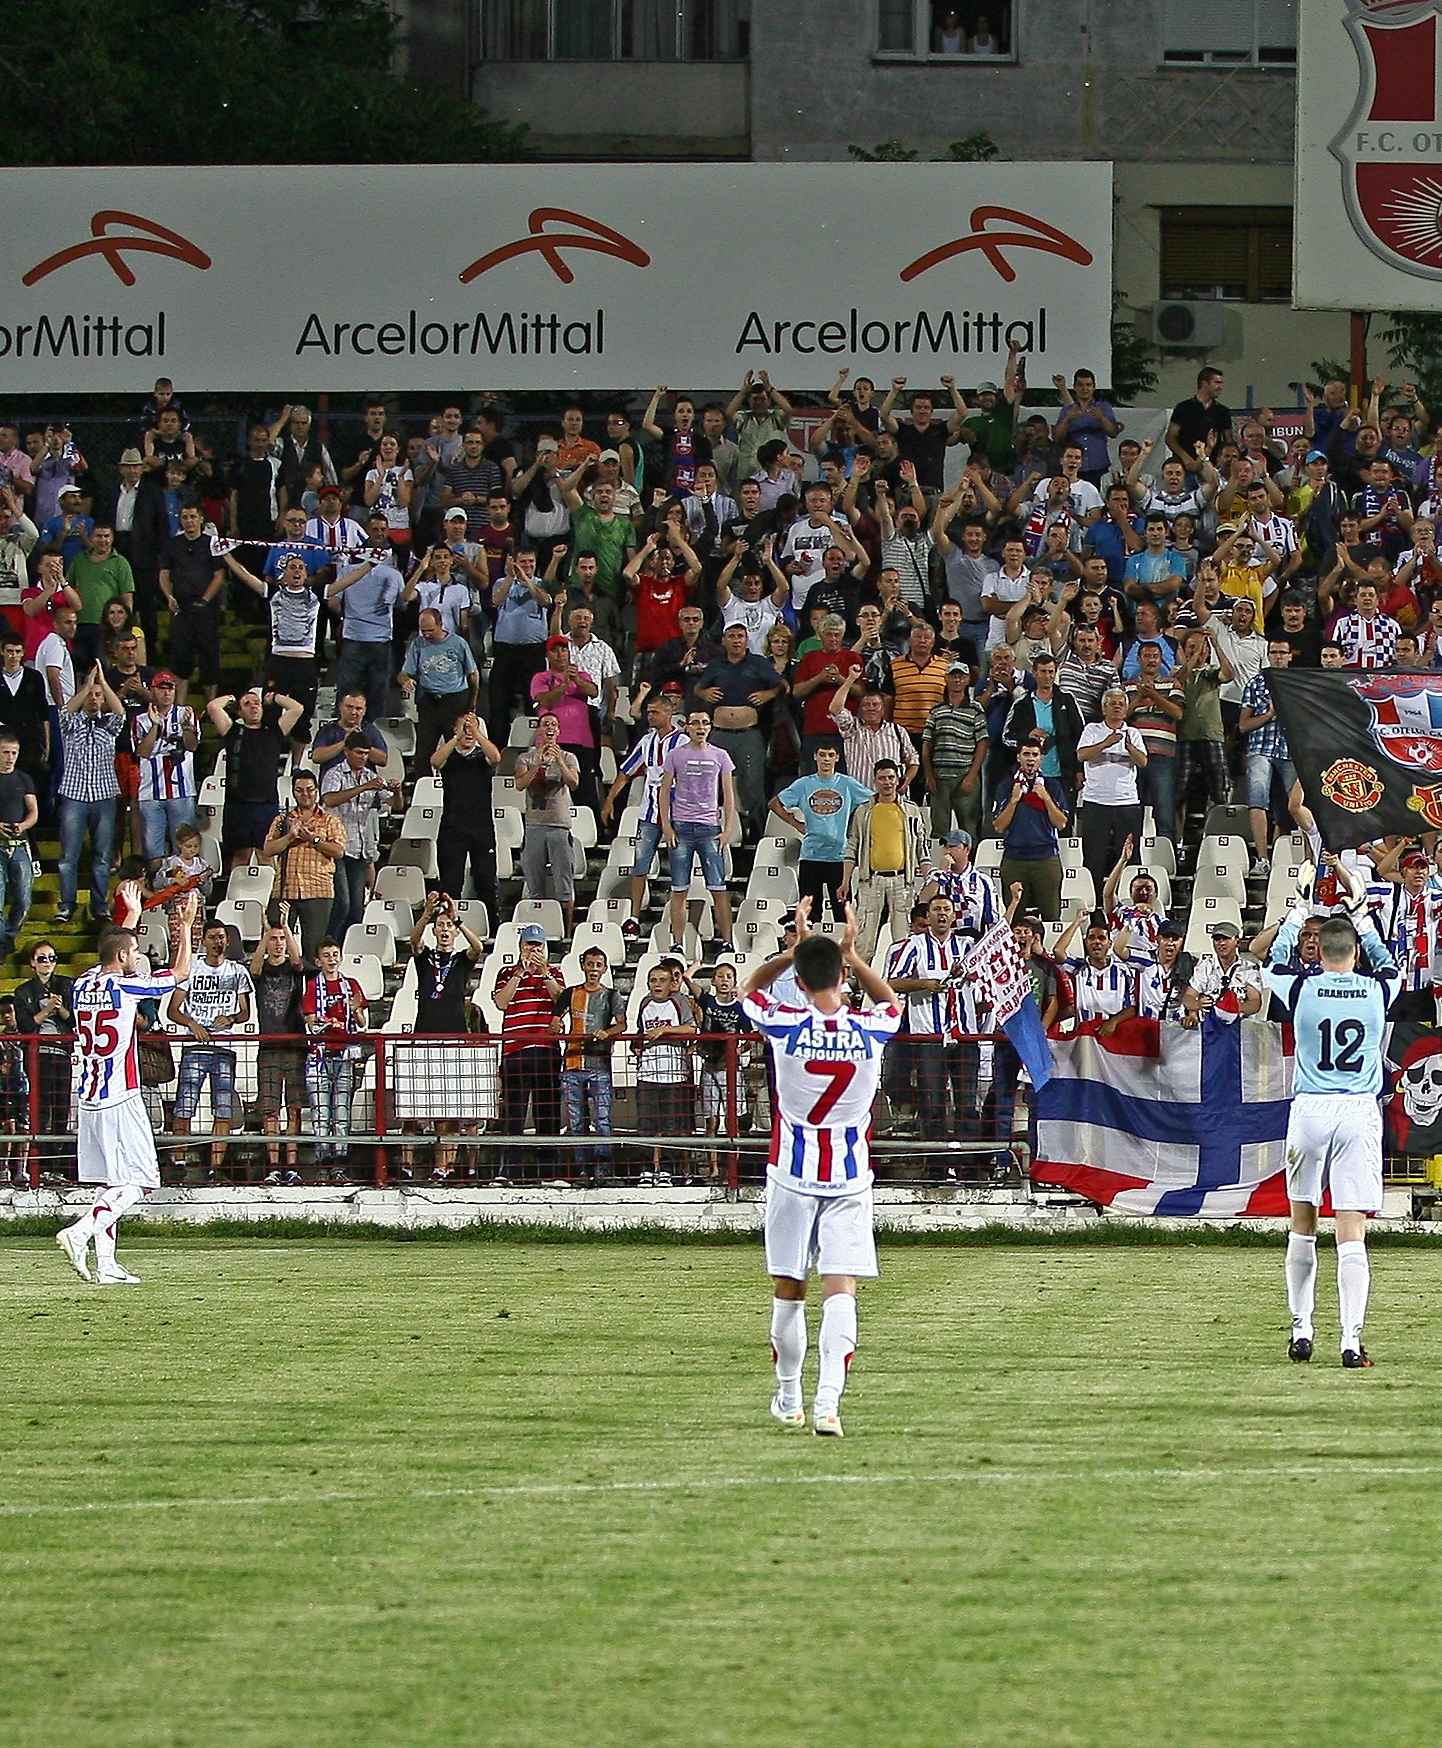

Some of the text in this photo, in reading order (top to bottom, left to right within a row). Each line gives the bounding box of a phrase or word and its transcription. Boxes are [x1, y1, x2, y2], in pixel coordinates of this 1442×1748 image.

[1356, 133, 1402, 152] F.C.
[295, 308, 604, 356] ArcelorMittal
[736, 307, 1046, 354] ArcelorMittal
[77, 990, 113, 1003] ASTRA
[77, 1010, 120, 1057] 55
[796, 1027, 865, 1049] ASTRA
[1317, 1018, 1366, 1073] 12
[805, 1060, 857, 1125] 7
